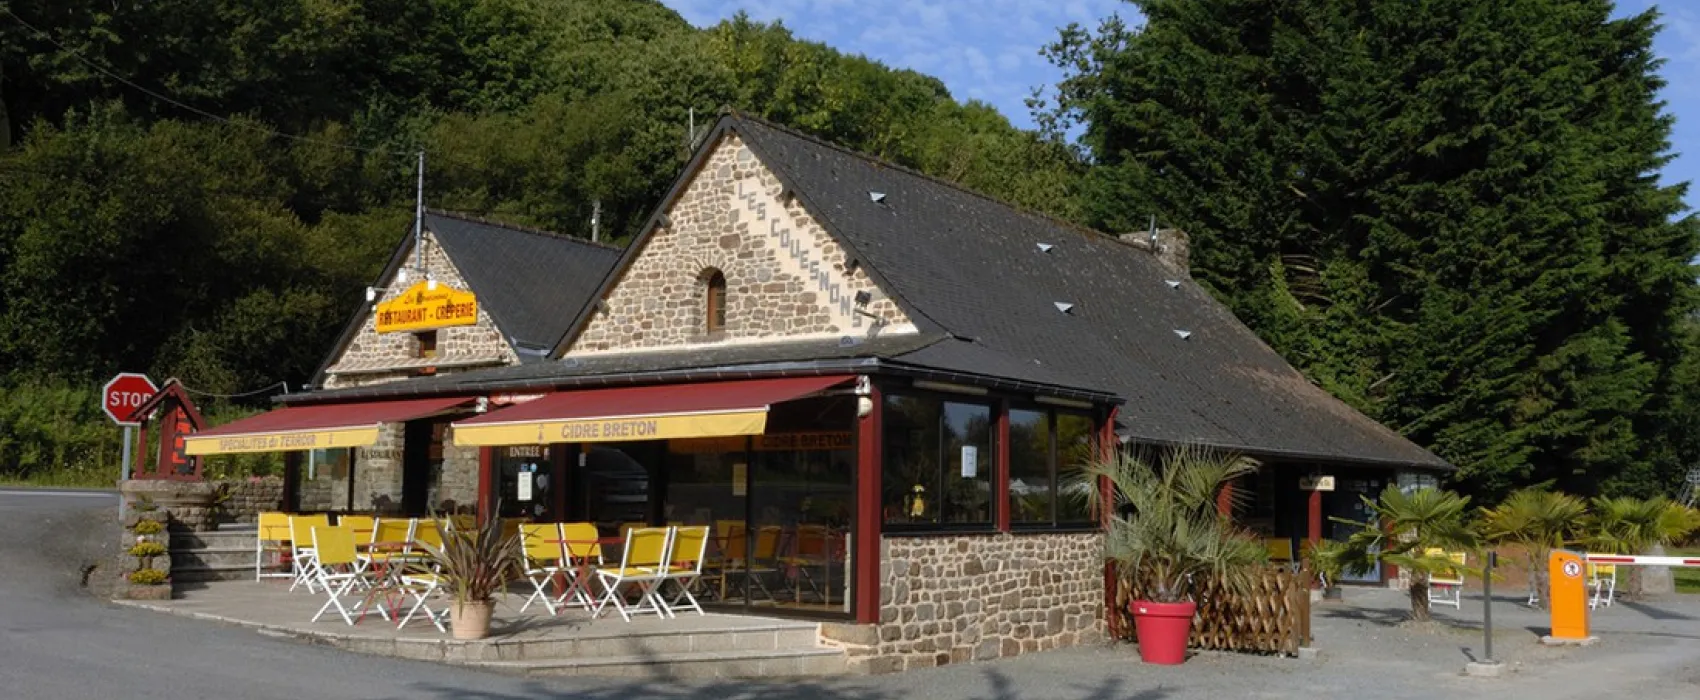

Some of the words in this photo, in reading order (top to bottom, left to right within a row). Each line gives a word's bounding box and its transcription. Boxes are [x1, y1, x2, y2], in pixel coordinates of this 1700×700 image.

[739, 183, 766, 220] LES
[771, 218, 862, 327] COUESNONS
[380, 308, 427, 325] RESTAURANT
[561, 424, 599, 439] CIDRE
[603, 421, 657, 438] BRETON
